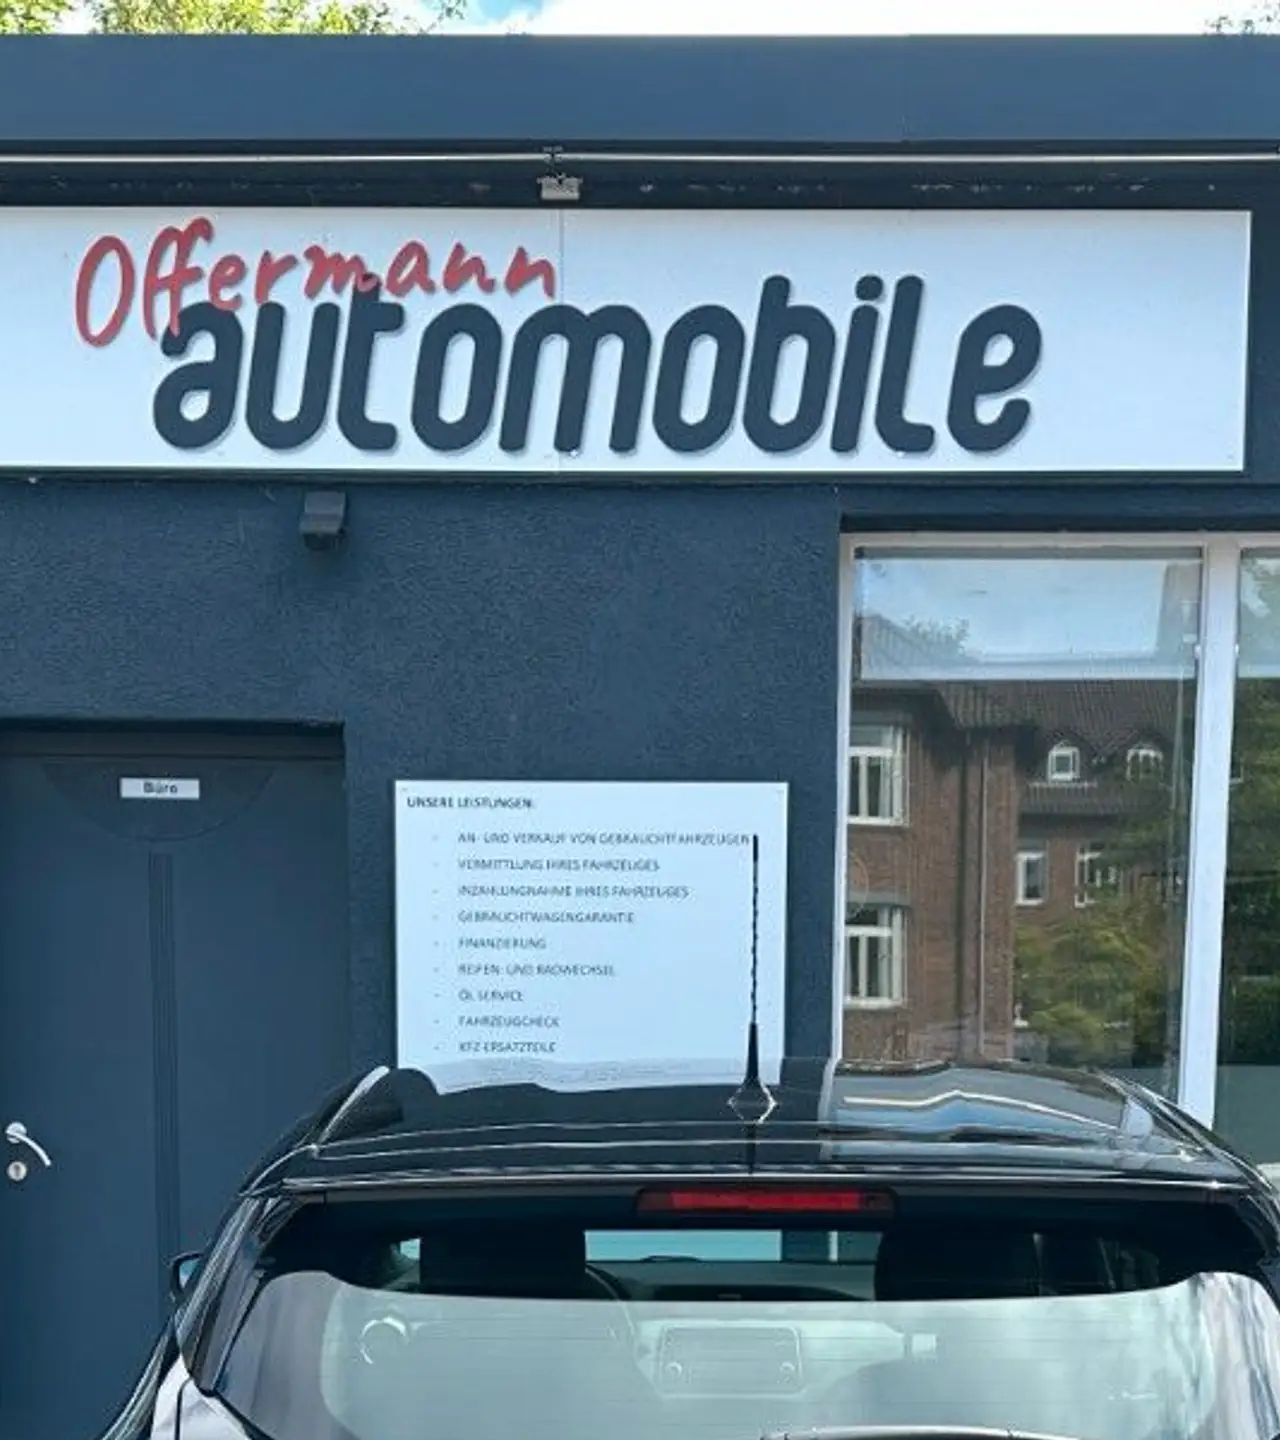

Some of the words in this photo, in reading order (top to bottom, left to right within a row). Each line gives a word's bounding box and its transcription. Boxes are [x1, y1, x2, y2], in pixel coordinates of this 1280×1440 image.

[76, 216, 556, 348] Offermann
[153, 272, 1044, 454] automobile
[406, 796, 454, 809] UNSERE
[483, 832, 510, 844] UND
[513, 832, 567, 844] VERKAUF
[570, 832, 597, 845] VON
[457, 858, 544, 871] VERMITTLUNG
[582, 859, 661, 872] FAHRZEUGES
[611, 885, 690, 899] FAHRZEUGES
[458, 937, 547, 950] FINANZIERUNG
[506, 963, 535, 976] UND
[458, 1015, 561, 1028] FAHRZEUGCHECK
